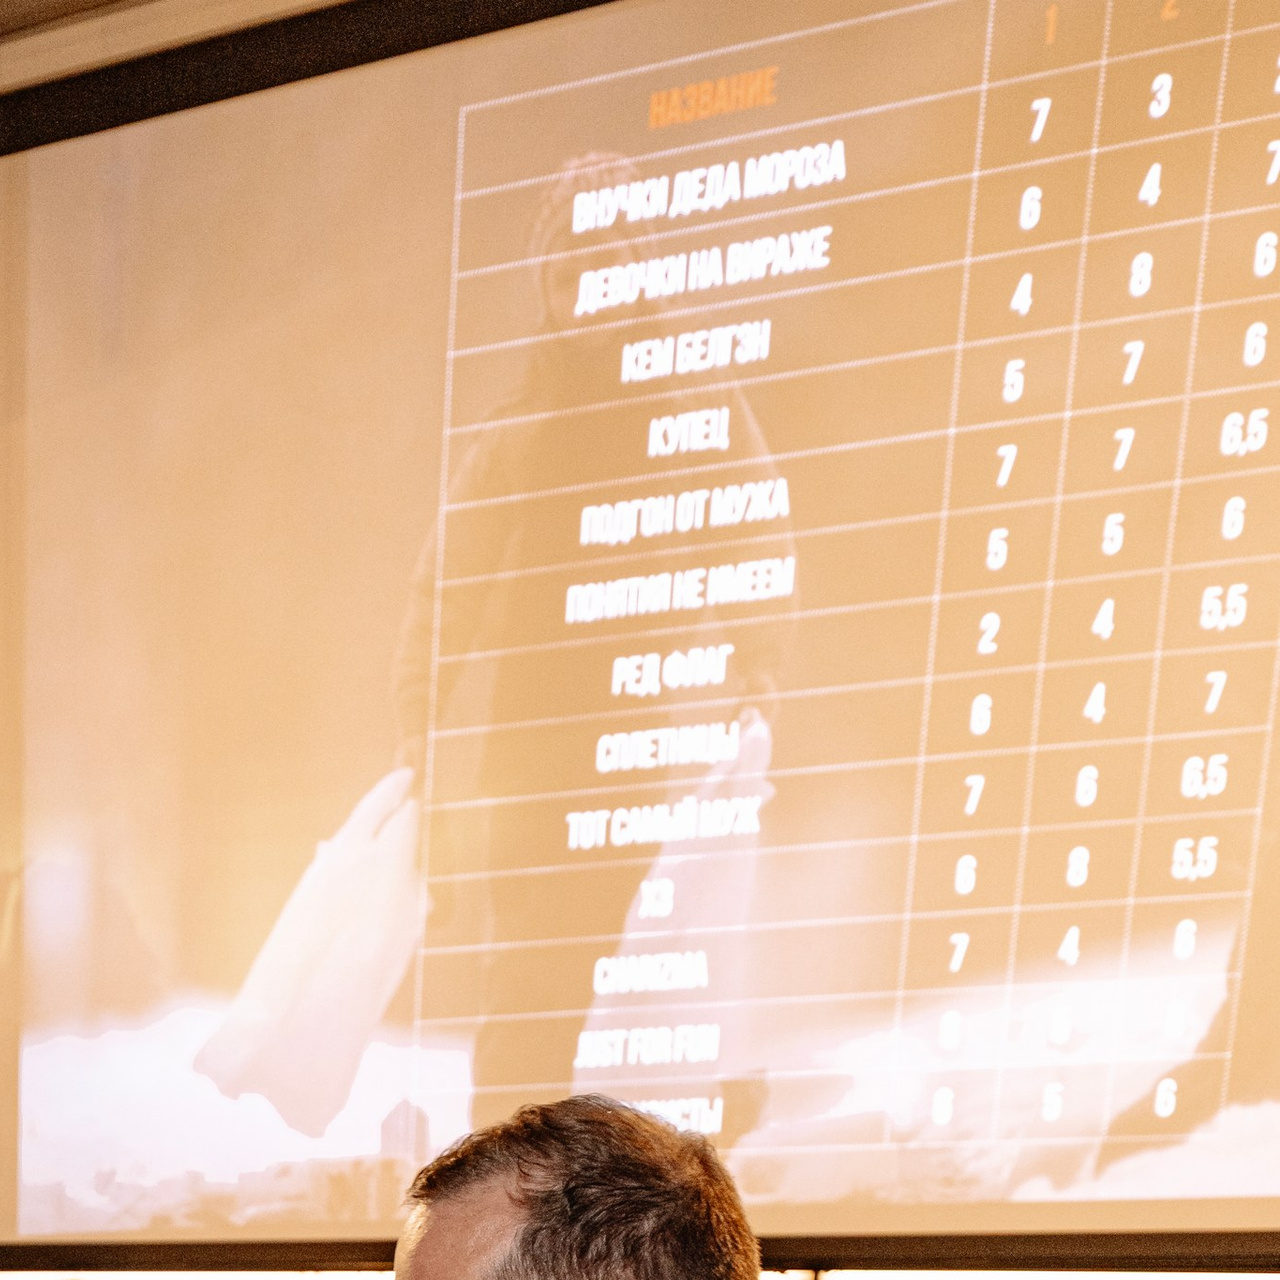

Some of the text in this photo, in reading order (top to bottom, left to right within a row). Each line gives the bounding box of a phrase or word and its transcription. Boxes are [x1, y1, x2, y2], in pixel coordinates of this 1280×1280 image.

[649, 68, 778, 128] НАЗВАНИЕ
[1148, 73, 1173, 119] 3
[1030, 97, 1052, 143] 7
[571, 139, 847, 234] ВНУЧКИ ДЕДА МОРОЗА
[1137, 162, 1162, 207] 4
[1019, 186, 1043, 231] 6
[573, 225, 833, 317] ДЕВОЧКИ НА ВИРАЖЕ
[1253, 231, 1279, 278] 6
[1009, 272, 1034, 316] 4
[620, 335, 675, 383] КЕМ
[1122, 340, 1145, 386] 7
[1242, 321, 1268, 367] 6
[647, 406, 731, 458] КУПЕЦ
[1113, 427, 1136, 472] 7
[1219, 407, 1270, 457] 6,5
[996, 443, 1018, 488] 7
[579, 476, 791, 546] ПОДГОН ОТ МУЖА
[1221, 496, 1246, 541] 6
[564, 555, 797, 624] ПОНЯТИЯ НЕ ИМЕЕМ
[977, 611, 1001, 655] 2
[1091, 598, 1115, 640] 4
[611, 643, 735, 698] РЕД ФЛАГ
[1204, 670, 1228, 714] 7
[969, 692, 993, 736] 6
[1083, 681, 1107, 725] 4
[595, 720, 740, 774] СПЛЕТНИЦЫ
[964, 774, 986, 816] 7
[1074, 764, 1099, 807] 6
[1180, 753, 1229, 800] 6,5
[565, 795, 763, 850] ТОТ САМЫЙ МУЖ
[948, 932, 971, 973] 7
[1056, 925, 1081, 968] 4
[573, 1023, 721, 1069] JUST FOR FUN
[1153, 1077, 1178, 1119] 6
